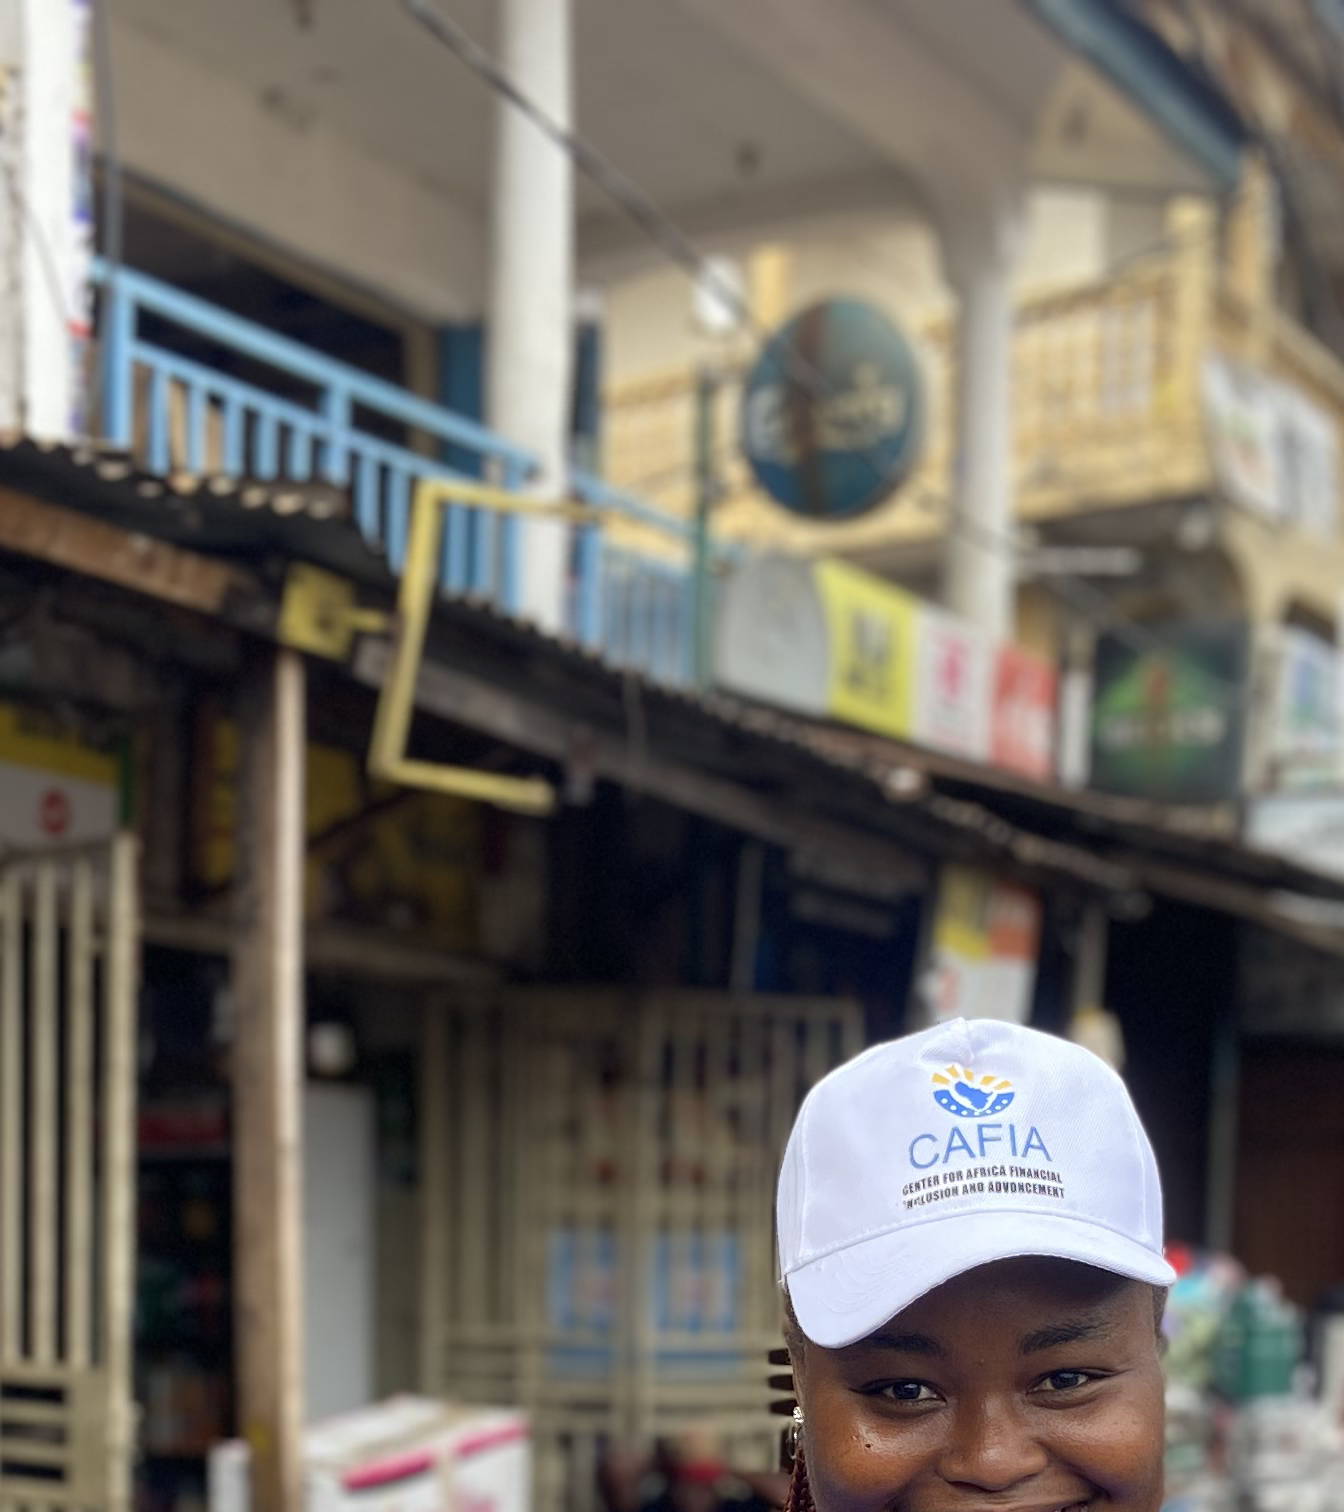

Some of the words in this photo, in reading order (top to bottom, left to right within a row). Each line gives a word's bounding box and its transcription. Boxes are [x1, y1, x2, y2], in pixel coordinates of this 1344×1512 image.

[908, 1123, 1053, 1170] CAFIA
[902, 1175, 940, 1196] CENTER
[943, 1170, 964, 1185] FOR
[966, 1165, 1007, 1180] AFRICA
[1009, 1165, 1063, 1184] FINANCIAL
[962, 1181, 985, 1195] AND
